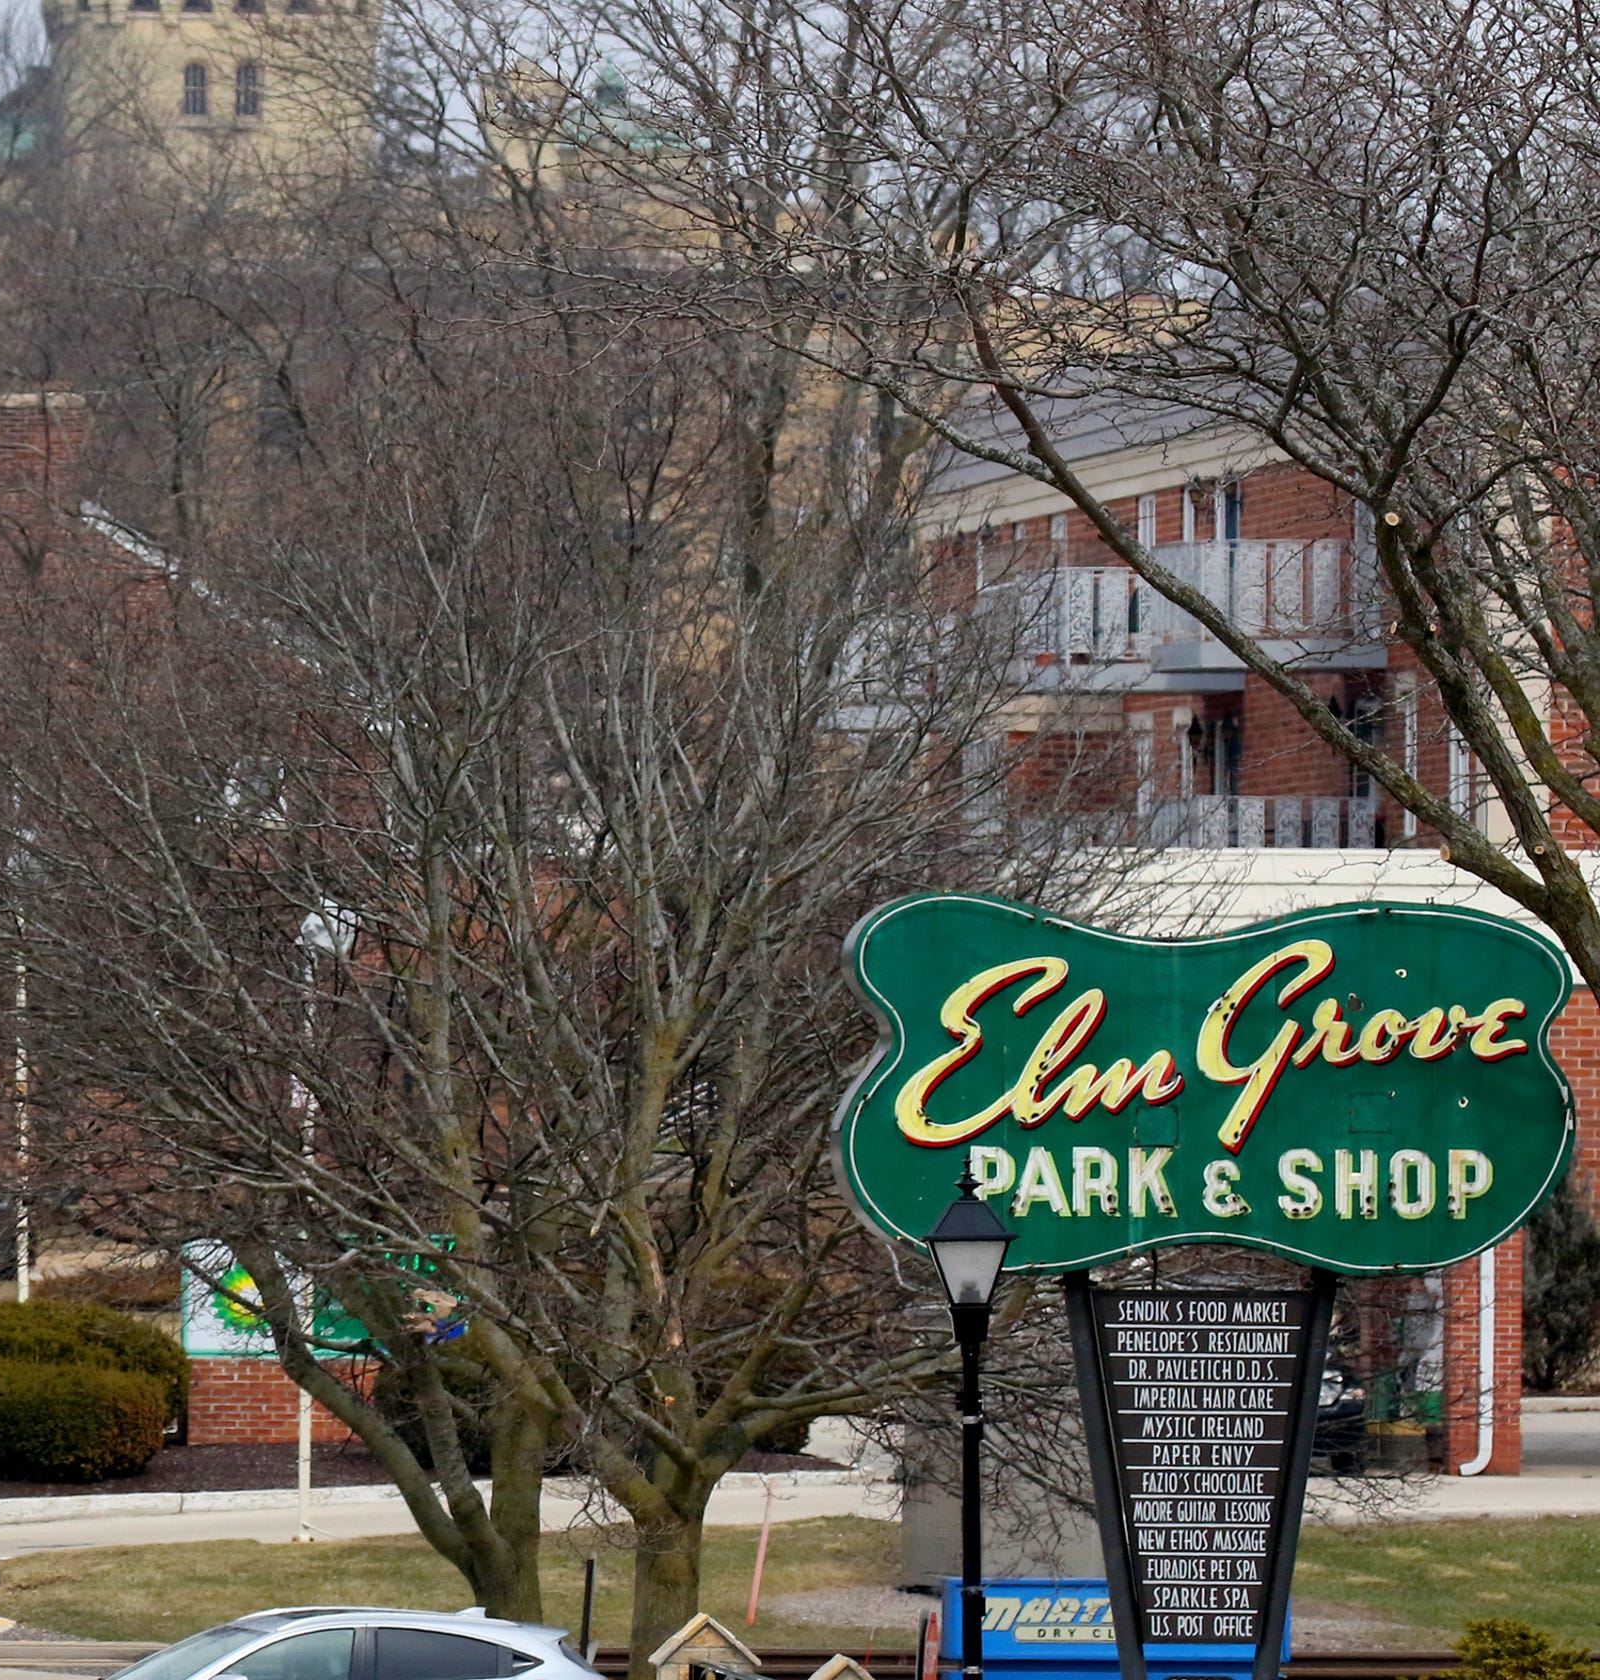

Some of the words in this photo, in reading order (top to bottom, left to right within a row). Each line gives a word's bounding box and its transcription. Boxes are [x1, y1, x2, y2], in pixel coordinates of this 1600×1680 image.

[895, 956, 1184, 1148] Elm
[1197, 938, 1529, 1154] Grove
[969, 1145, 1179, 1219] PARK
[1202, 1160, 1251, 1218] &
[1277, 1148, 1494, 1220] SHOP
[1188, 1301, 1228, 1323] FOOD
[1231, 1301, 1288, 1323] MARKET
[1117, 1330, 1199, 1353] PENELOPE'S
[1208, 1331, 1291, 1353] RESTAURANT
[1128, 1358, 1152, 1380] DR.
[1156, 1359, 1232, 1381] PAVLETICH
[1236, 1360, 1279, 1381] D.D.S.
[1134, 1387, 1198, 1409] IMPERIAL
[1202, 1388, 1236, 1409] HAIR
[1240, 1388, 1274, 1409] CARE
[1142, 1416, 1196, 1438] MYSTIC
[1201, 1417, 1265, 1438] IRELAND
[1152, 1444, 1201, 1466] PAPER
[1211, 1444, 1255, 1466] ENVY
[1142, 1471, 1190, 1493] FAZIO'S
[1193, 1472, 1264, 1494] CHOCOLATE
[1133, 1500, 1173, 1522] MOORE
[1177, 1500, 1216, 1522] GUITAR
[1225, 1501, 1271, 1523] LESSONS
[1138, 1529, 1166, 1550] NEW
[1170, 1529, 1208, 1551] ETHOS
[1212, 1529, 1267, 1552] MASSAGE
[1146, 1558, 1206, 1580] FURADISE
[1210, 1559, 1232, 1580] PET
[1236, 1559, 1258, 1581] SPA
[1153, 1586, 1218, 1609] SPARKLE
[1223, 1587, 1250, 1609] SPA
[1037, 1628, 1077, 1638] DRY
[1151, 1615, 1173, 1637] U.S.
[1177, 1615, 1205, 1637] POST
[1213, 1615, 1253, 1637] OFFICE
